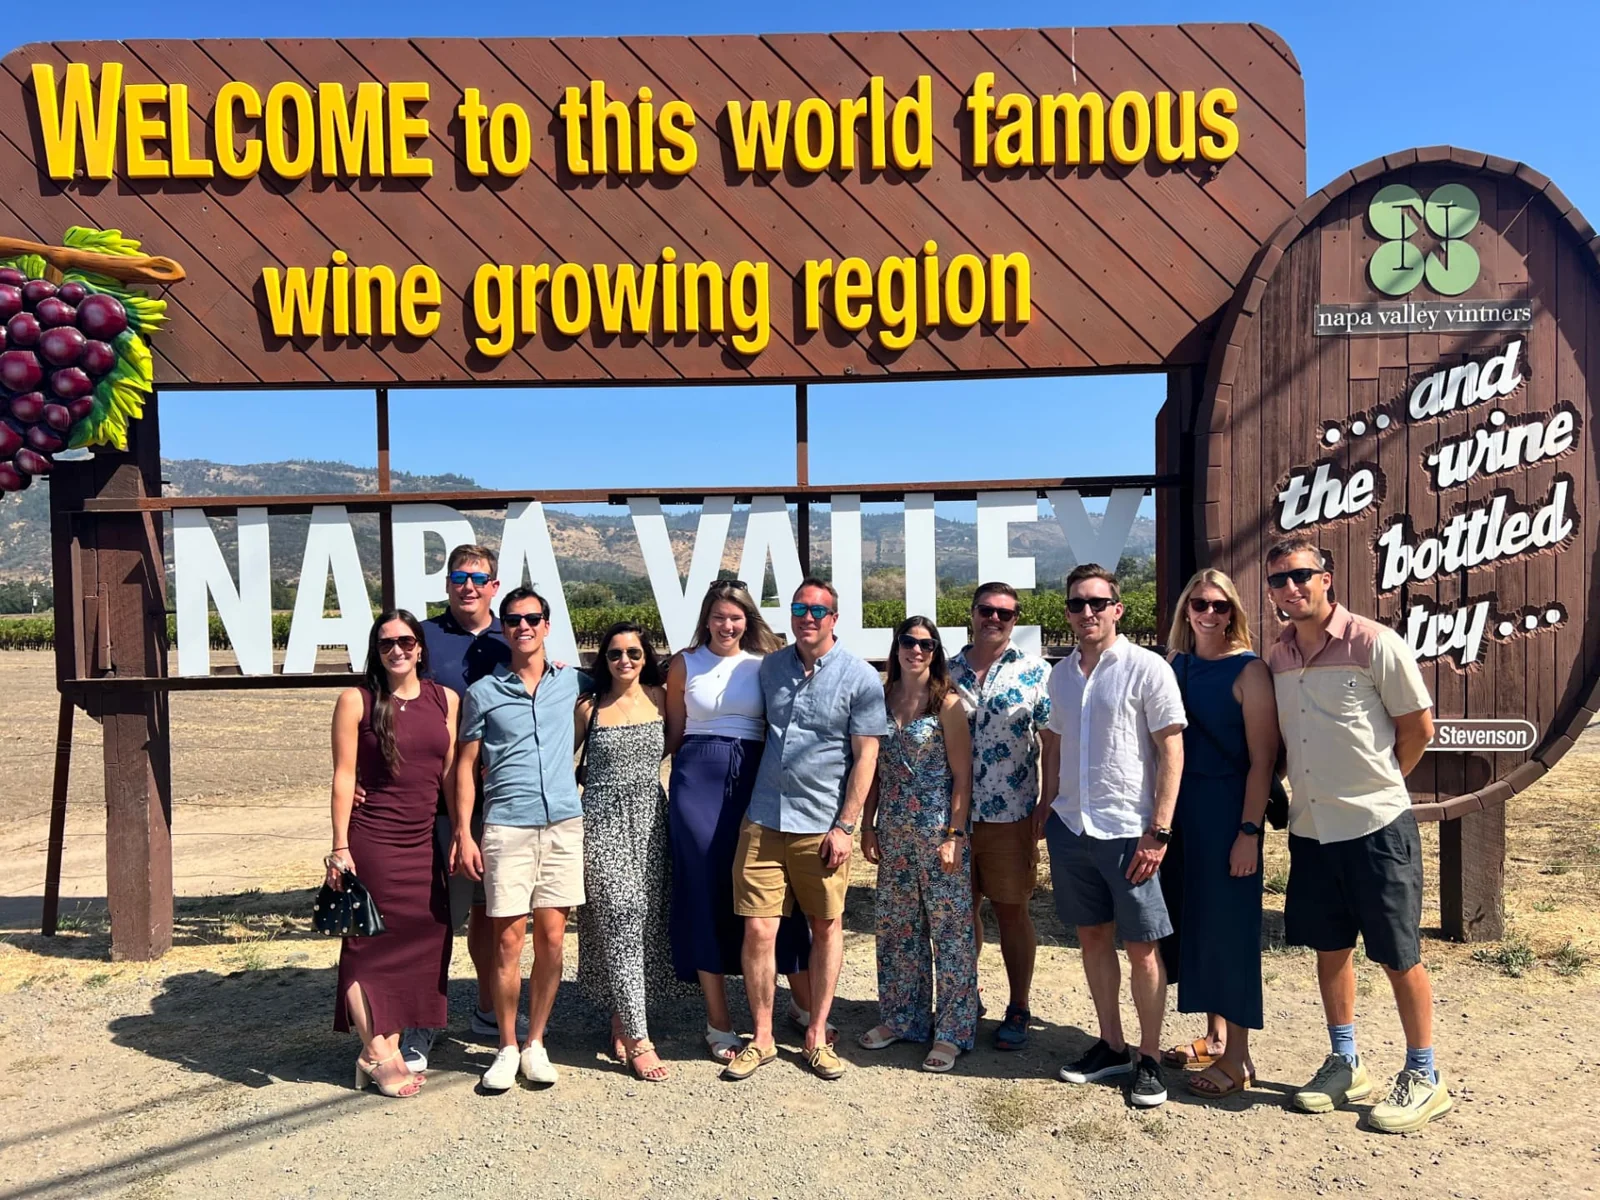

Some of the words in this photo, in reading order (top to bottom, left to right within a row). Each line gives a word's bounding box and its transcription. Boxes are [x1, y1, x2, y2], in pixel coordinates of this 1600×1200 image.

[32, 62, 433, 180] WELCOME
[459, 88, 532, 176] to
[560, 81, 698, 175] this
[728, 76, 934, 172] world
[967, 72, 1239, 167] famous
[262, 250, 442, 337] wine
[474, 247, 770, 357] growing
[804, 240, 1031, 350] region
[1318, 311, 1373, 333] napa
[1378, 304, 1441, 330] valley
[1444, 303, 1532, 324] vintners
[1278, 463, 1374, 530] the
[1428, 411, 1573, 487] wine
[172, 501, 582, 677] NAPA
[627, 487, 1146, 660] VALLEY
[1379, 481, 1572, 589] bottled
[1439, 725, 1527, 746] Stevenson
